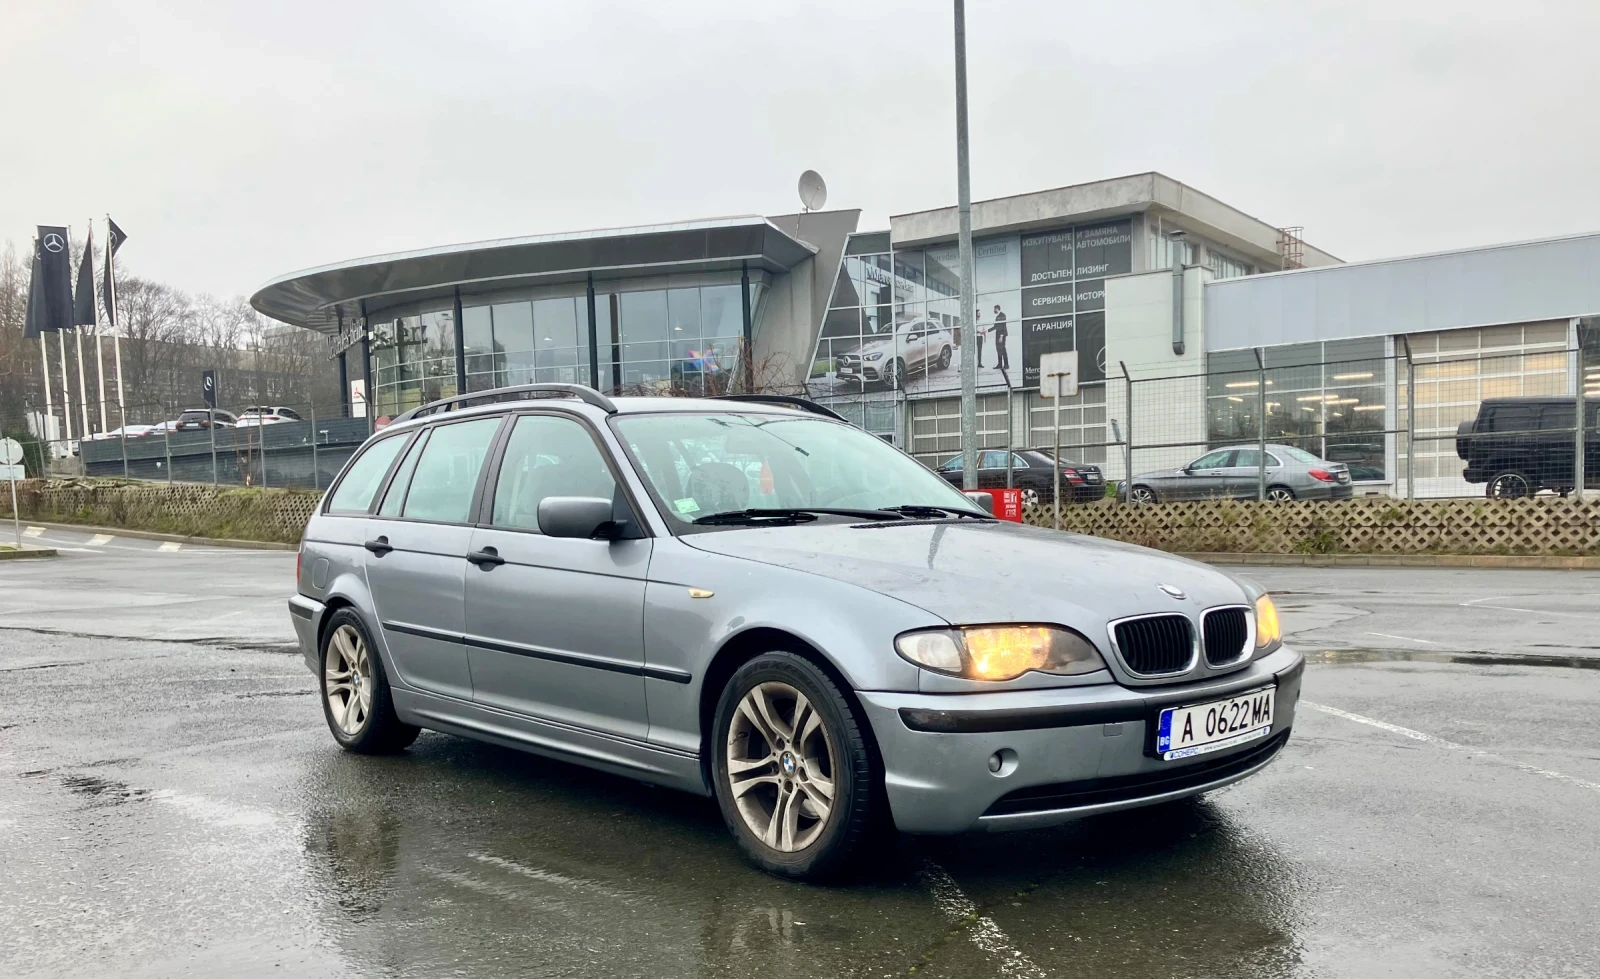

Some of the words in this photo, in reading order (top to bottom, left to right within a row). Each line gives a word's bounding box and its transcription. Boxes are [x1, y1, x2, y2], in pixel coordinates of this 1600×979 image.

[1022, 233, 1072, 247] ИЗКУПУВАНЕ
[1076, 231, 1083, 239] И
[1084, 226, 1118, 238] ЗАМЯНА
[1061, 243, 1072, 252] НА
[1076, 234, 1131, 249] АВТОМОБИЛИ
[978, 244, 1007, 256] Certified
[1031, 269, 1073, 282] ДОСТЪПЕН
[1076, 264, 1109, 276] ЛИЗИНГ
[1032, 295, 1073, 306] СЕРВИЗНА
[1032, 320, 1073, 332] ГАРАНЦИЯ
[1160, 736, 1170, 746] BG
